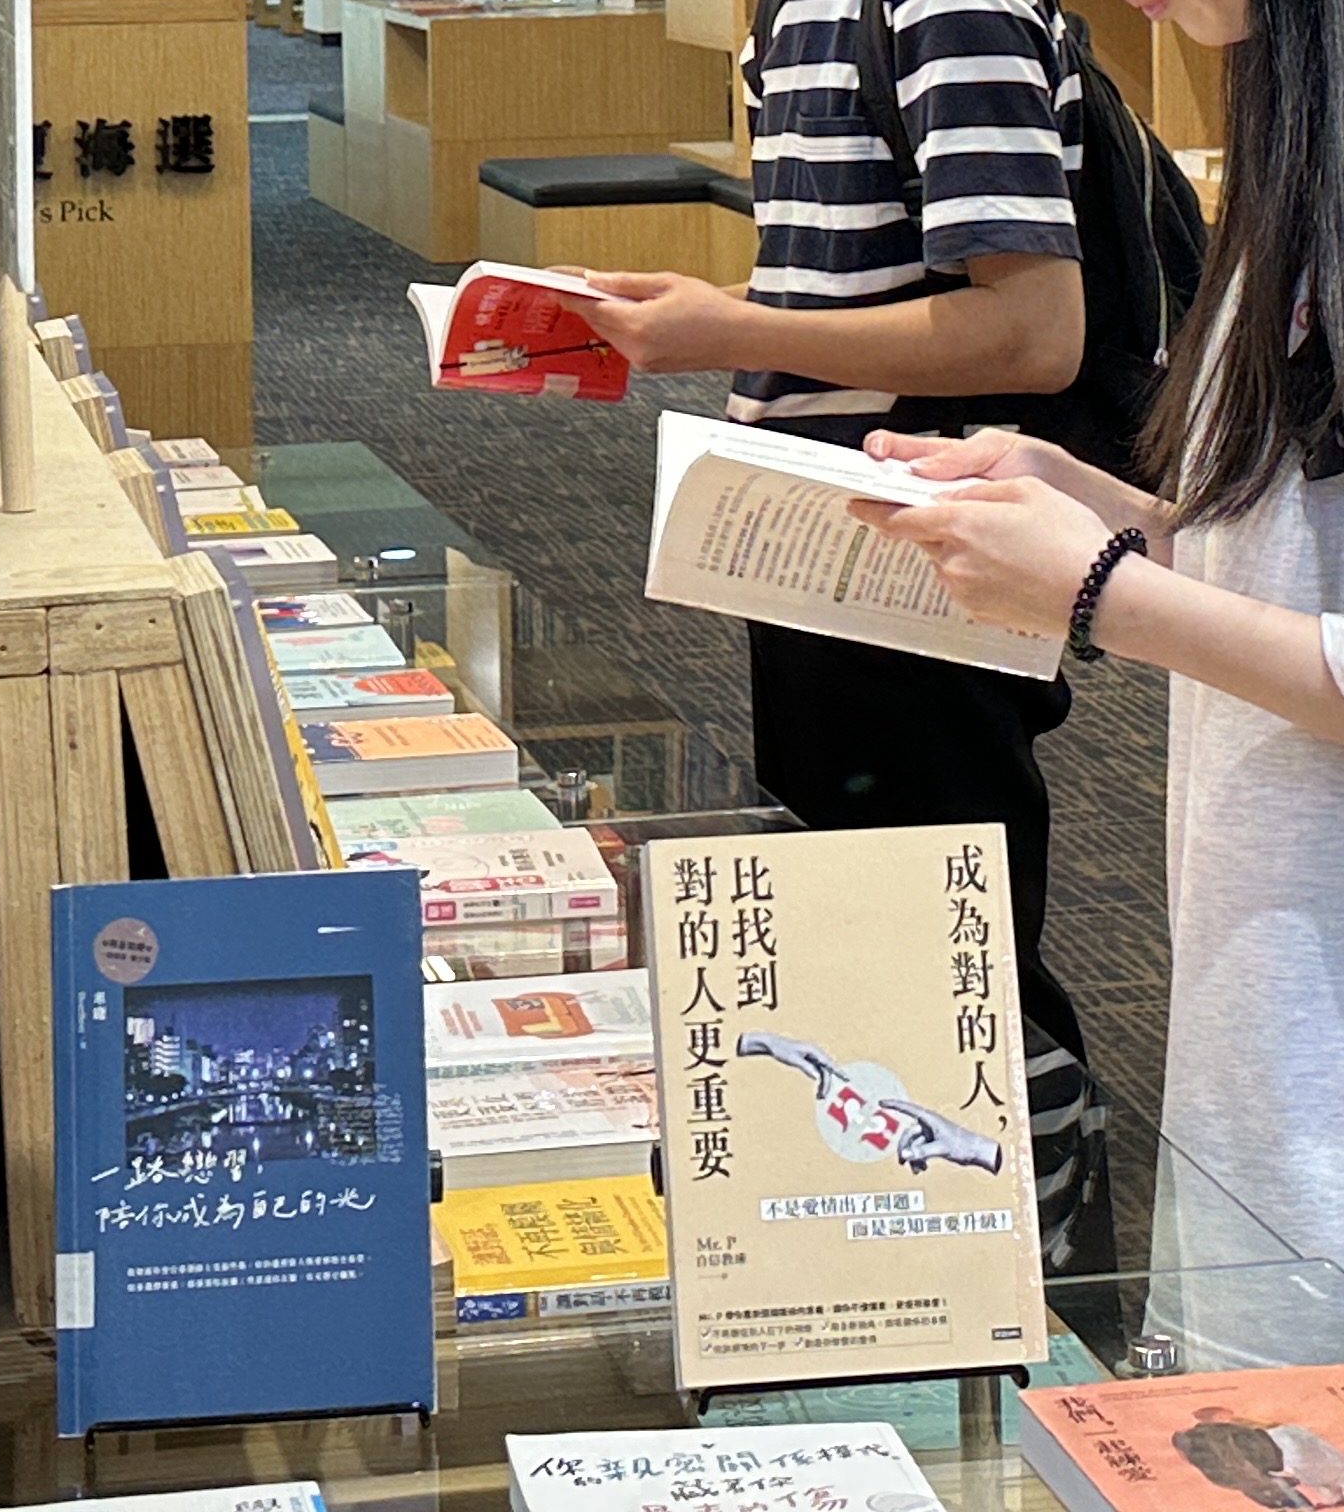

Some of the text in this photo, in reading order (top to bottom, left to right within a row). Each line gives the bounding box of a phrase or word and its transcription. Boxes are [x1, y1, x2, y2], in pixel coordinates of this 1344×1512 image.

[60, 199, 115, 223] Pick
[730, 855, 779, 1011] 比找到
[673, 855, 735, 1182] 對的人更重要
